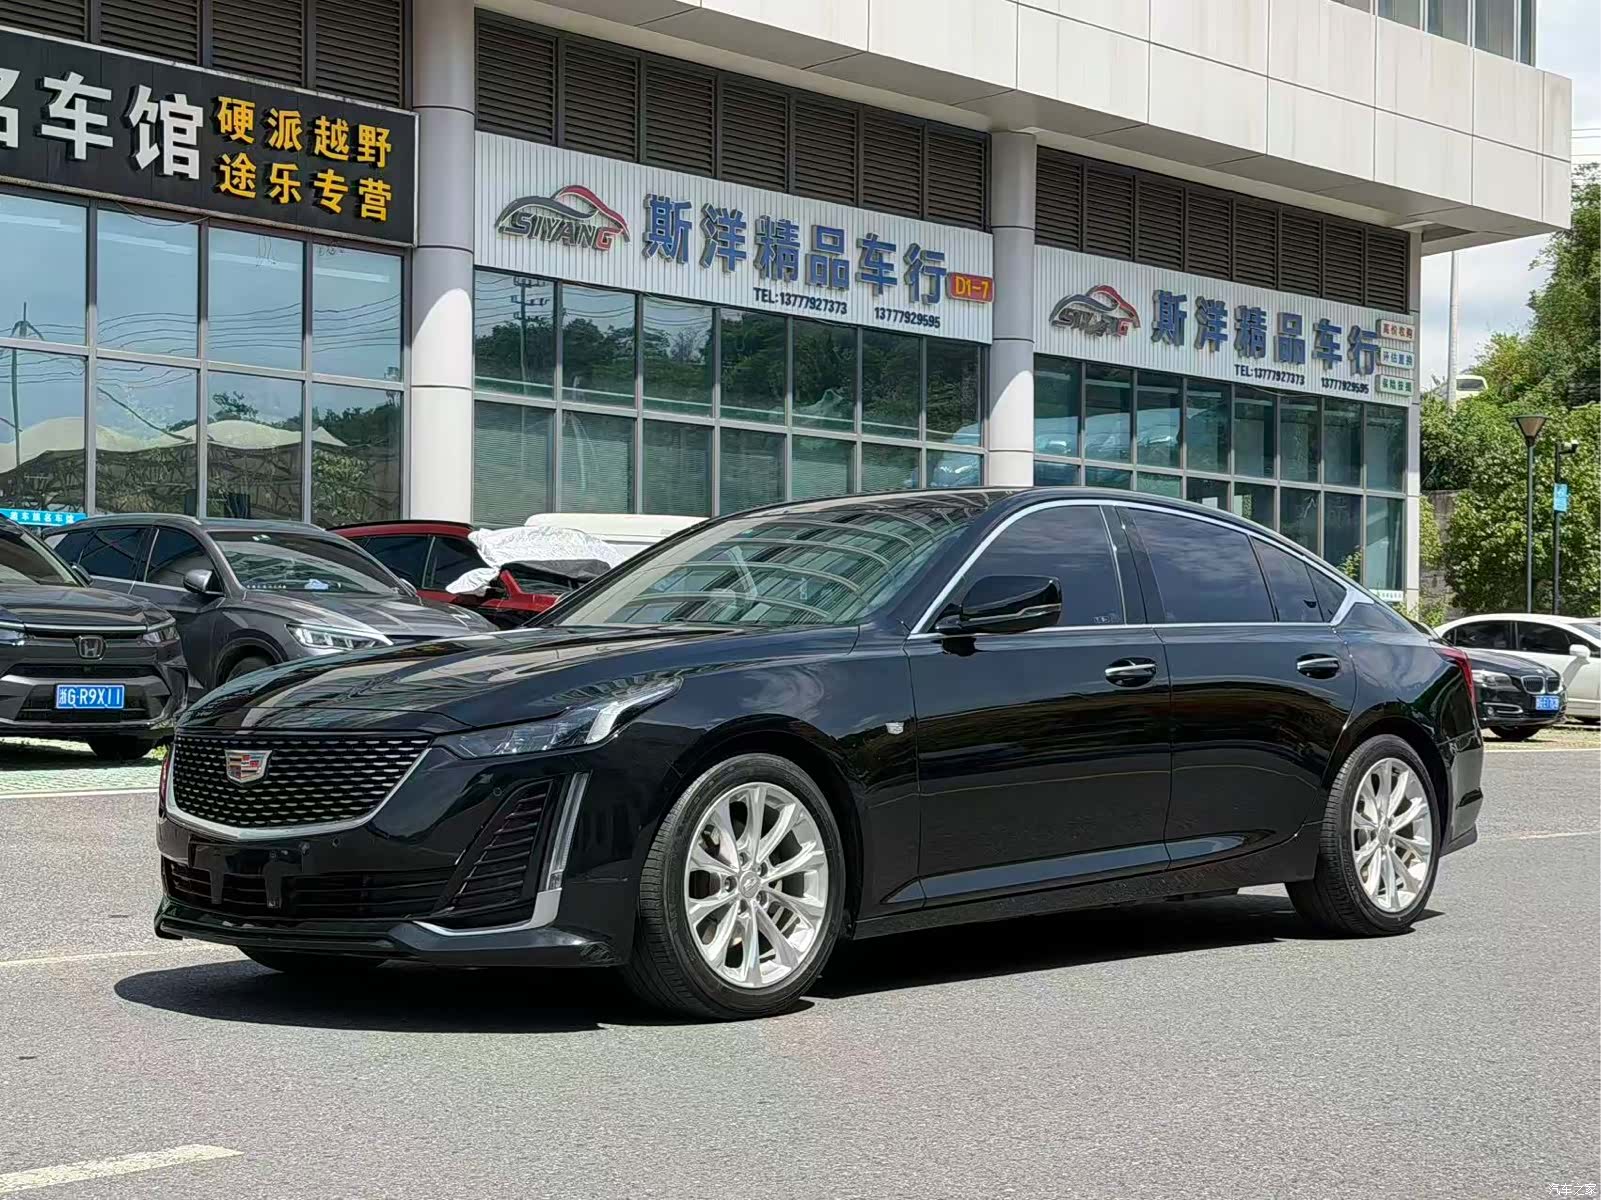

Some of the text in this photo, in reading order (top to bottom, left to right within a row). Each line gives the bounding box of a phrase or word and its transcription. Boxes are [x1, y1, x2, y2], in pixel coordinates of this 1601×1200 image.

[217, 96, 392, 168] 硬派越野
[218, 152, 392, 222] 途乐专营
[498, 211, 624, 251] SIYANG
[643, 193, 948, 304] 斯洋精品车行
[753, 287, 941, 329] TEL:13777927373 13777929595
[955, 277, 989, 299] D1-7
[1151, 289, 1380, 376] 斯洋精品车行
